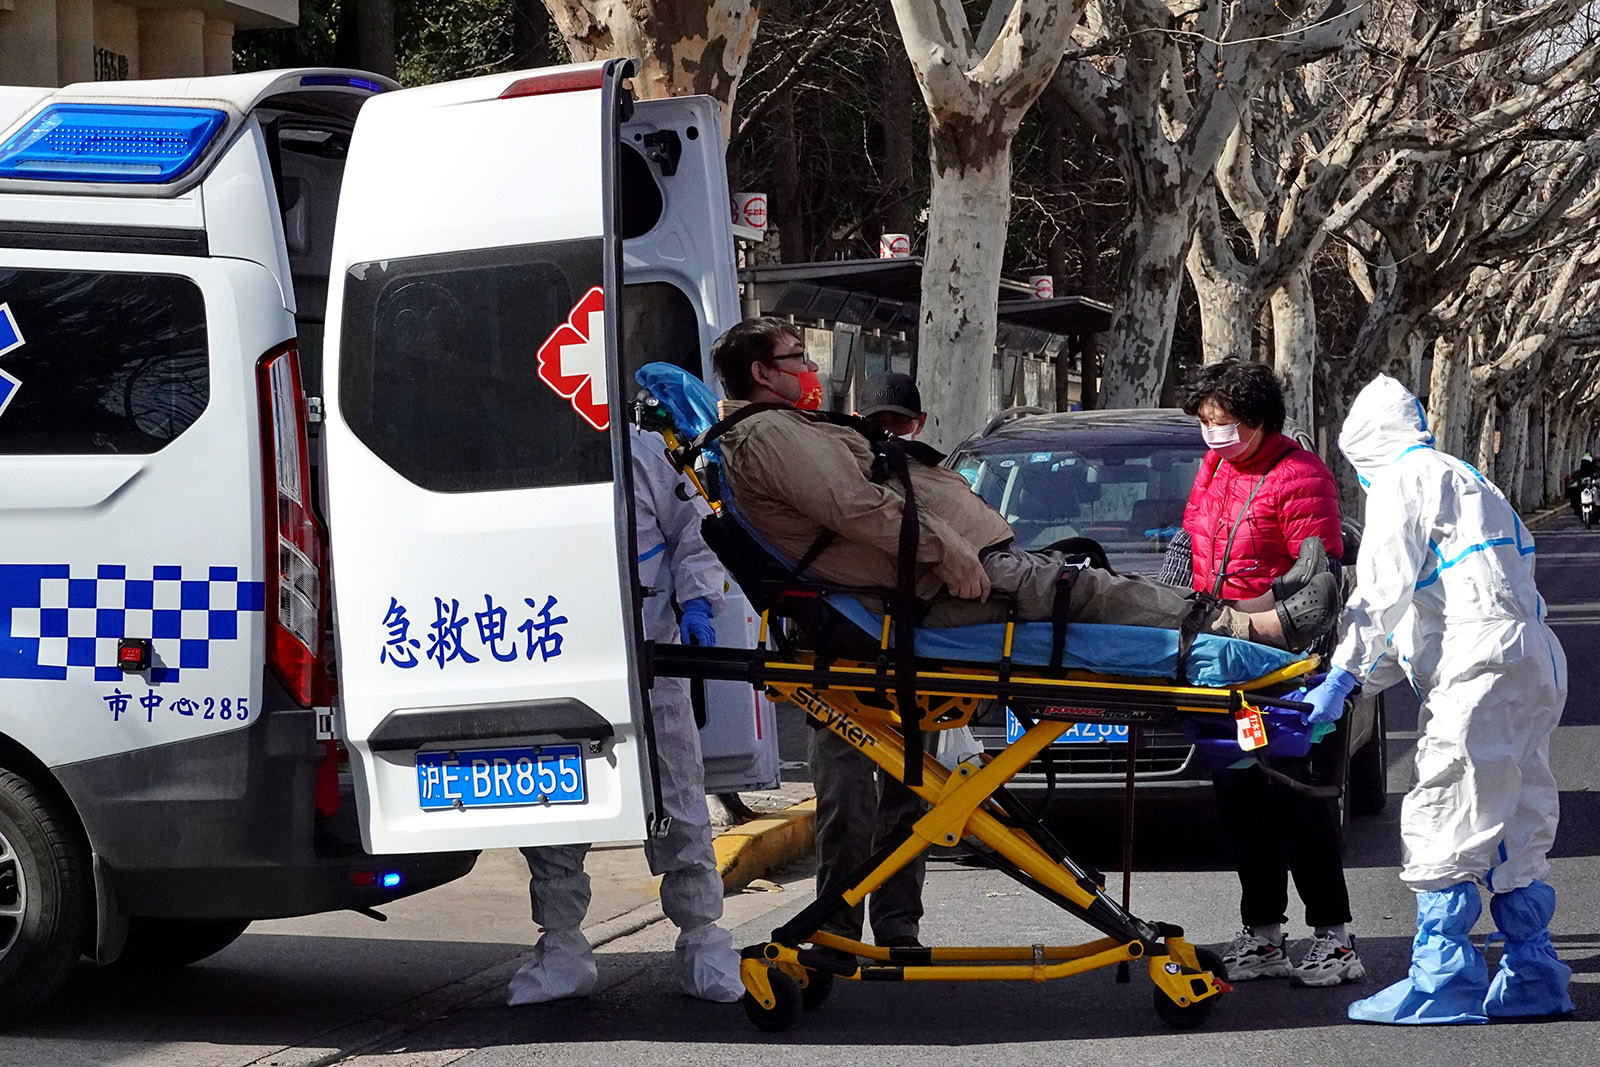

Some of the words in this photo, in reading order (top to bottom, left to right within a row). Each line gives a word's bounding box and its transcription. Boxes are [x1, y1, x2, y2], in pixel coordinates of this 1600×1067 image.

[380, 594, 568, 670] 急救电话
[103, 688, 249, 722] 市中心285
[421, 754, 579, 799] 沪E·BR855
